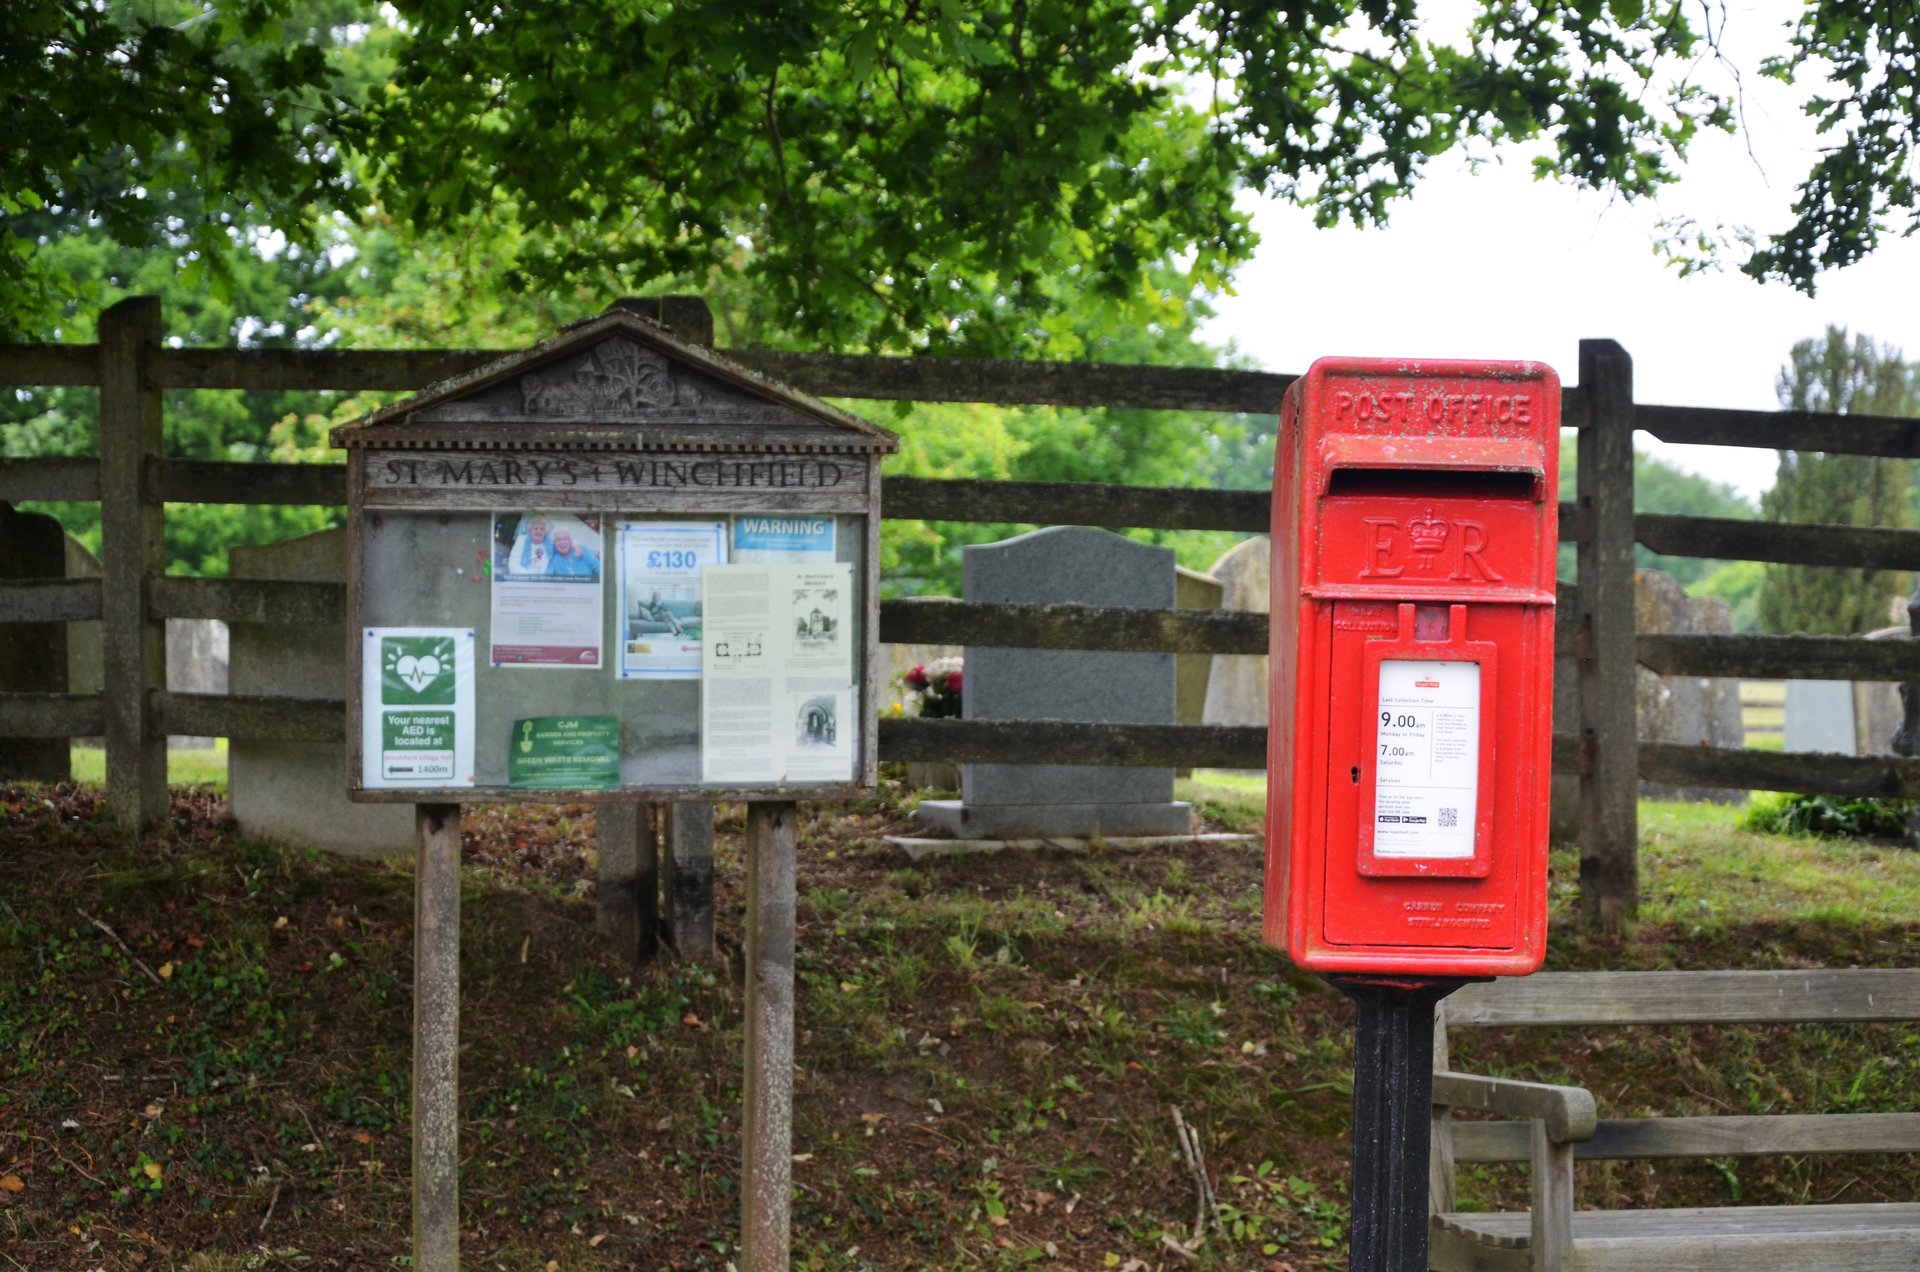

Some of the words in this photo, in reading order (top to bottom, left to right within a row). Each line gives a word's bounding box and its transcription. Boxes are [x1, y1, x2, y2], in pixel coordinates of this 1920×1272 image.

[1335, 391, 1415, 423] POST
[1424, 394, 1532, 426] OFFICE
[386, 459, 425, 484] ST
[439, 459, 577, 486] MARY'S
[616, 461, 842, 487] WINCHFIELD
[743, 518, 825, 535] WARNING
[1357, 516, 1404, 579] E
[1449, 518, 1503, 582] R
[646, 550, 697, 569] £130
[387, 715, 411, 725] Your
[413, 715, 450, 725] nearest
[557, 721, 579, 729] CJM
[402, 726, 424, 735] AED
[426, 726, 436, 735] is
[395, 736, 431, 746] located
[433, 737, 443, 746] at
[516, 757, 542, 765] GREEN
[544, 756, 571, 764] WASTE
[573, 755, 610, 764] REMOVAL
[418, 765, 448, 774] 1400m
